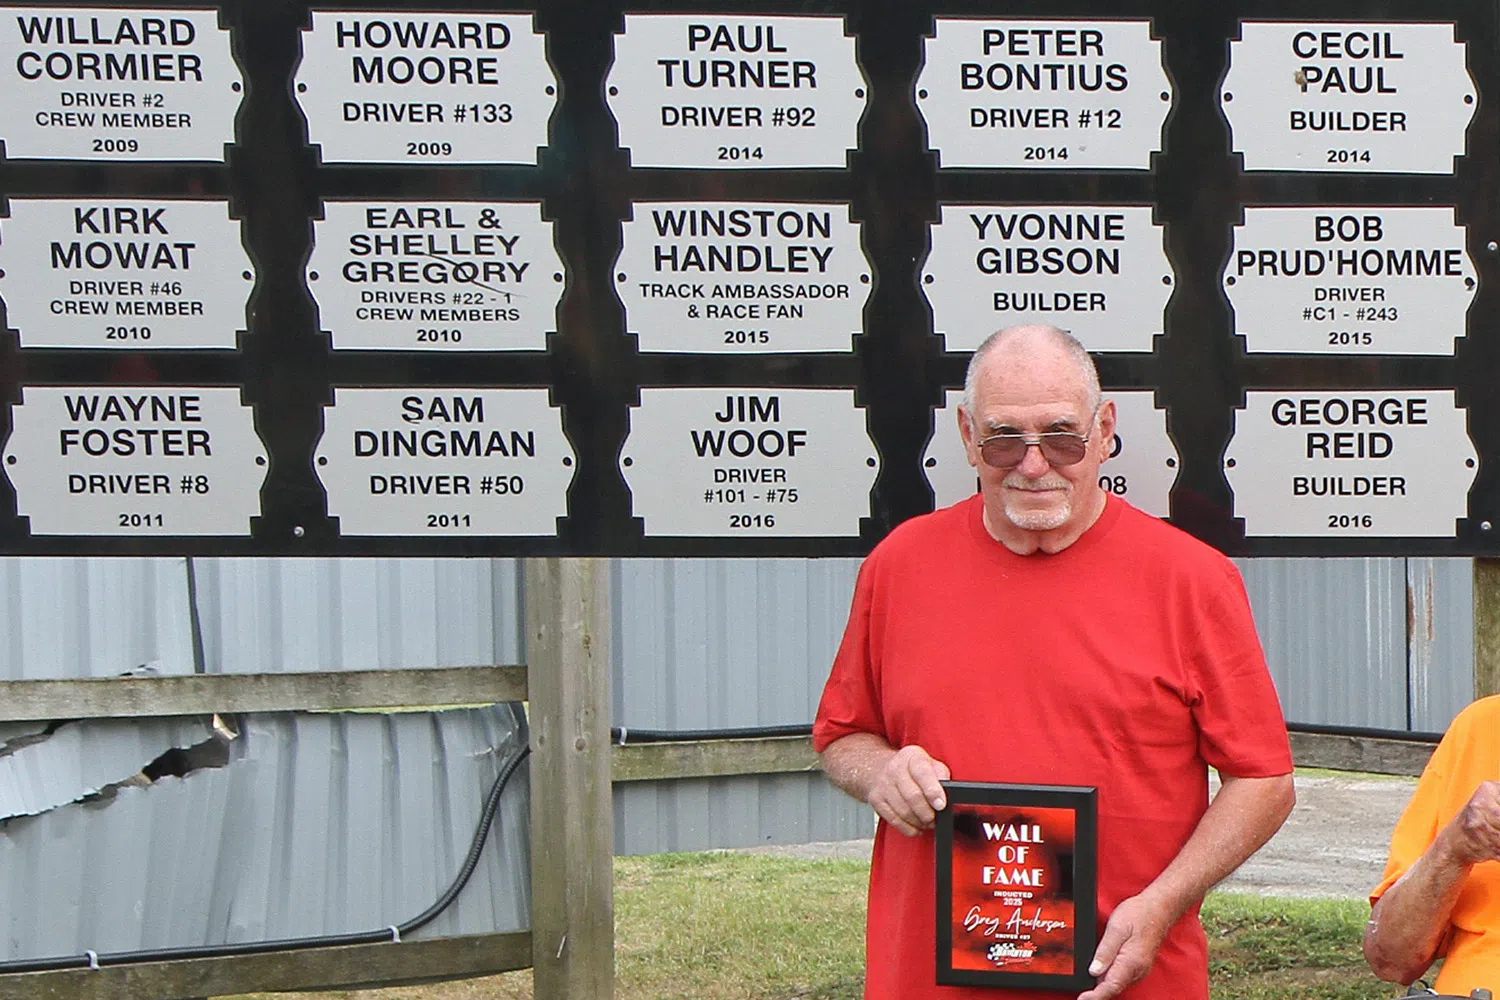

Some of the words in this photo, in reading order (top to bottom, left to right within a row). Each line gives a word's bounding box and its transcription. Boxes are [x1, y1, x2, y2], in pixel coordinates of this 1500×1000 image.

[16, 16, 196, 46] WILLARD
[336, 20, 511, 50] HOWARD
[688, 24, 788, 53] PAUL
[983, 29, 1104, 57] PETER
[1292, 31, 1404, 59] CECIL
[16, 51, 203, 82] CORMIER
[352, 56, 499, 85] MOORE
[657, 59, 817, 89] TURNER
[960, 62, 1128, 92] BONTIUS
[1302, 66, 1397, 94] PAUL
[60, 92, 136, 108] DRIVER
[142, 93, 164, 108] #2
[35, 111, 96, 127] CREW
[102, 113, 192, 128] MEMBER
[343, 102, 444, 123] DRIVER
[453, 103, 513, 123] #133
[661, 106, 763, 127] DRIVER
[771, 107, 816, 127] #92
[970, 108, 1069, 128] DRIVER
[1078, 108, 1121, 129] #12
[1290, 110, 1406, 132] BUILDER
[92, 138, 139, 153] 2009
[406, 142, 452, 156] 2009
[718, 146, 764, 160] 2014
[1024, 146, 1069, 160] 2014
[1327, 149, 1371, 163] 2014
[74, 207, 169, 235] KIRK
[366, 207, 466, 229] EARL
[477, 208, 502, 229] &
[651, 209, 831, 239] WINSTON
[969, 213, 1125, 241] YVONNE
[1315, 215, 1383, 242] BOB
[50, 241, 196, 270] MOWAT
[349, 234, 520, 256] SHELLEY
[654, 245, 834, 273] HANDLEY
[976, 247, 1120, 275] GIBSON
[1237, 249, 1463, 277] PRUD'HOMME
[342, 261, 530, 284] GREGORY
[69, 280, 144, 296] DRIVER
[150, 281, 182, 296] #46
[361, 290, 446, 305] DRIVERS
[452, 292, 484, 305] #22
[504, 292, 511, 304] 1
[639, 283, 705, 299] TRACK
[711, 284, 849, 299] AMBASSADOR
[1314, 287, 1385, 302] DRIVER
[50, 299, 109, 315] CREW
[115, 301, 204, 316] MEMBER
[687, 304, 700, 319] &
[706, 304, 760, 319] RACE
[766, 304, 803, 319] FAN
[993, 292, 1106, 312] BUILDER
[355, 307, 414, 321] CREW
[420, 308, 520, 322] MEMBERS
[1303, 306, 1335, 321] #C1
[1356, 307, 1398, 321] #243
[105, 326, 151, 340] 2010
[416, 329, 462, 343] 2010
[724, 330, 770, 344] 2015
[1328, 331, 1372, 345] 2015
[63, 395, 202, 423] WAYNE
[401, 396, 484, 424] SAM
[715, 395, 780, 423] JIM
[1271, 398, 1428, 426] GEORGE
[60, 428, 212, 457] FOSTER
[354, 429, 535, 458] DINGMAN
[690, 429, 807, 458] WOOF
[1306, 432, 1393, 459] REID
[68, 474, 171, 495] DRIVER
[180, 474, 210, 495] #8
[370, 475, 471, 495] DRIVER
[479, 475, 524, 495] #50
[714, 468, 787, 483] DRIVER
[1098, 475, 1128, 496] 08
[1293, 476, 1406, 496] BUILDER
[704, 488, 745, 504] #101
[766, 488, 799, 503] #75
[118, 513, 163, 527] 2011
[427, 514, 471, 528] 2011
[729, 514, 775, 528] 2016
[1328, 515, 1373, 528] 2016
[982, 822, 1044, 843] WALL
[998, 845, 1030, 864] OF
[982, 866, 1044, 887] FAME
[993, 890, 1033, 898] INDUCTED
[1003, 898, 1023, 906] 2025
[964, 906, 1000, 936] Greg
[1006, 907, 1067, 934] Anderson
